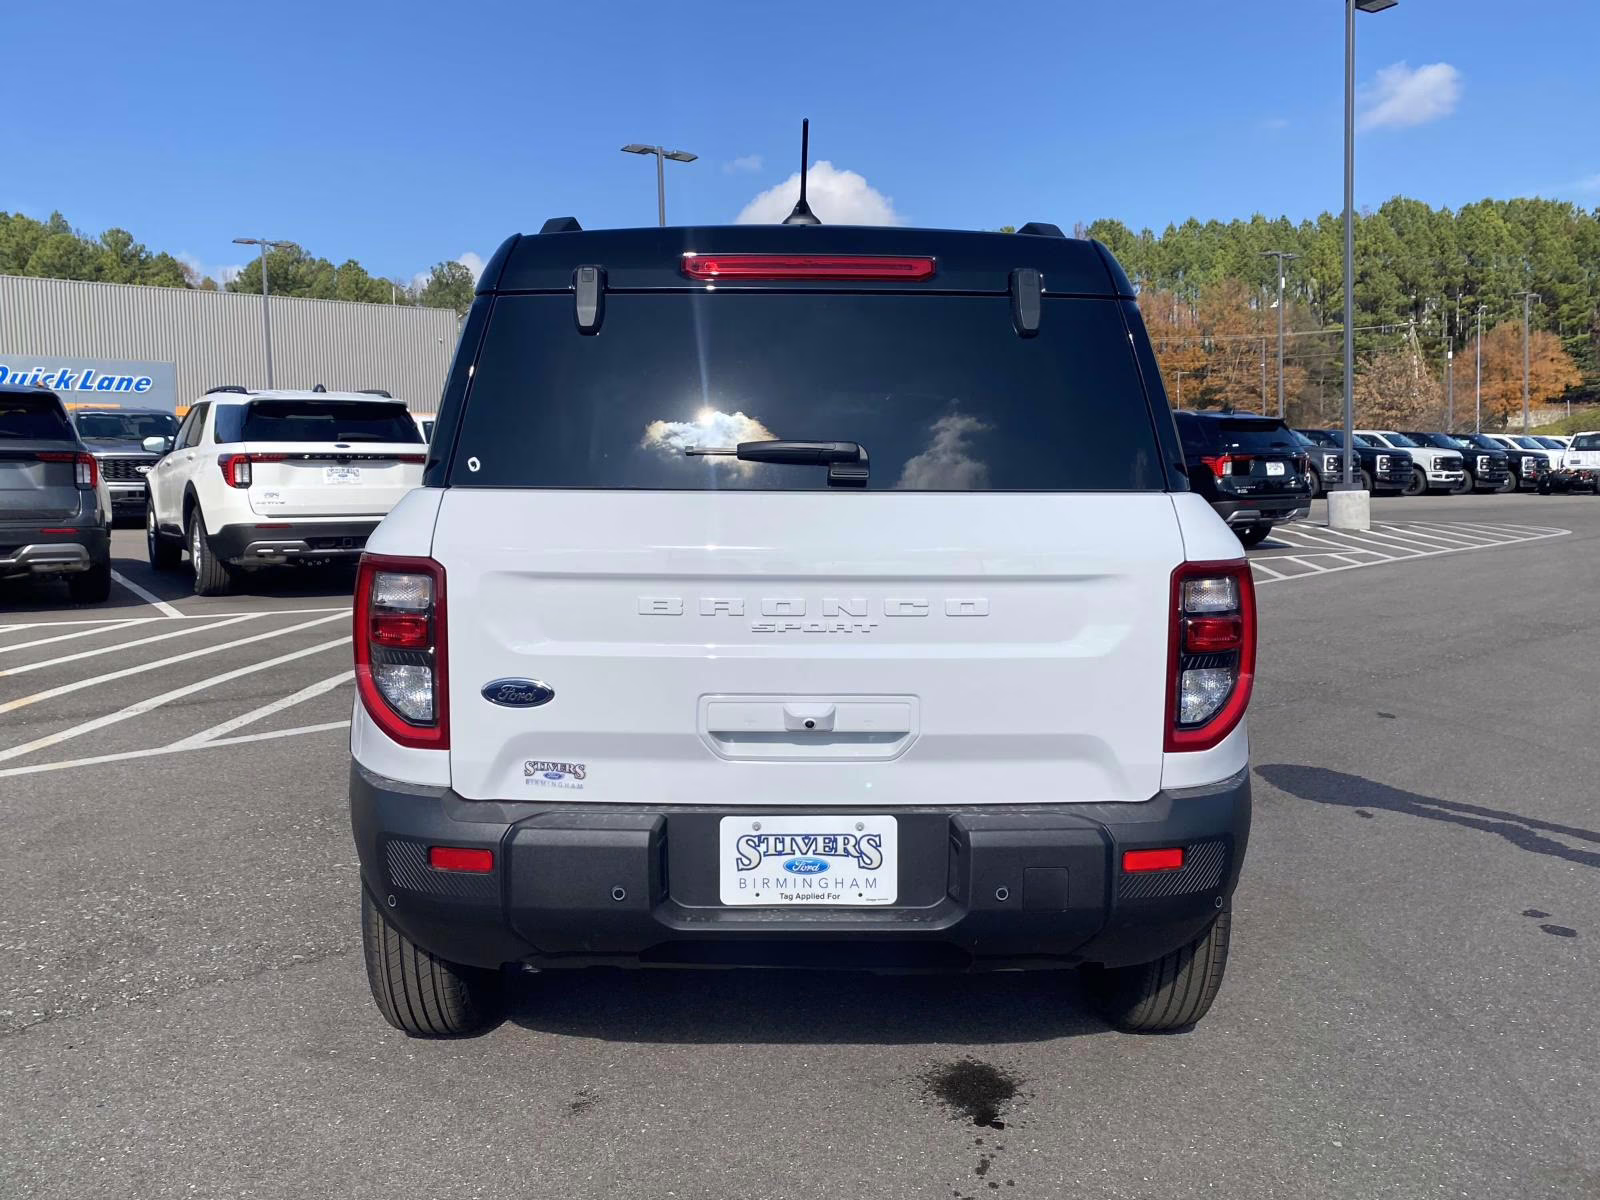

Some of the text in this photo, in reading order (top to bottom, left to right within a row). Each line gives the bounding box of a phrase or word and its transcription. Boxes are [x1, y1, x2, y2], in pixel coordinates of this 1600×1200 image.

[75, 368, 153, 393] Lane
[638, 597, 990, 617] BRONCO
[751, 622, 878, 633] SPORT
[524, 760, 586, 780] STIVERS
[736, 833, 883, 871] STIVERS
[739, 877, 877, 889] BIRMINGHAM
[780, 892, 841, 902] Tag Applied For
